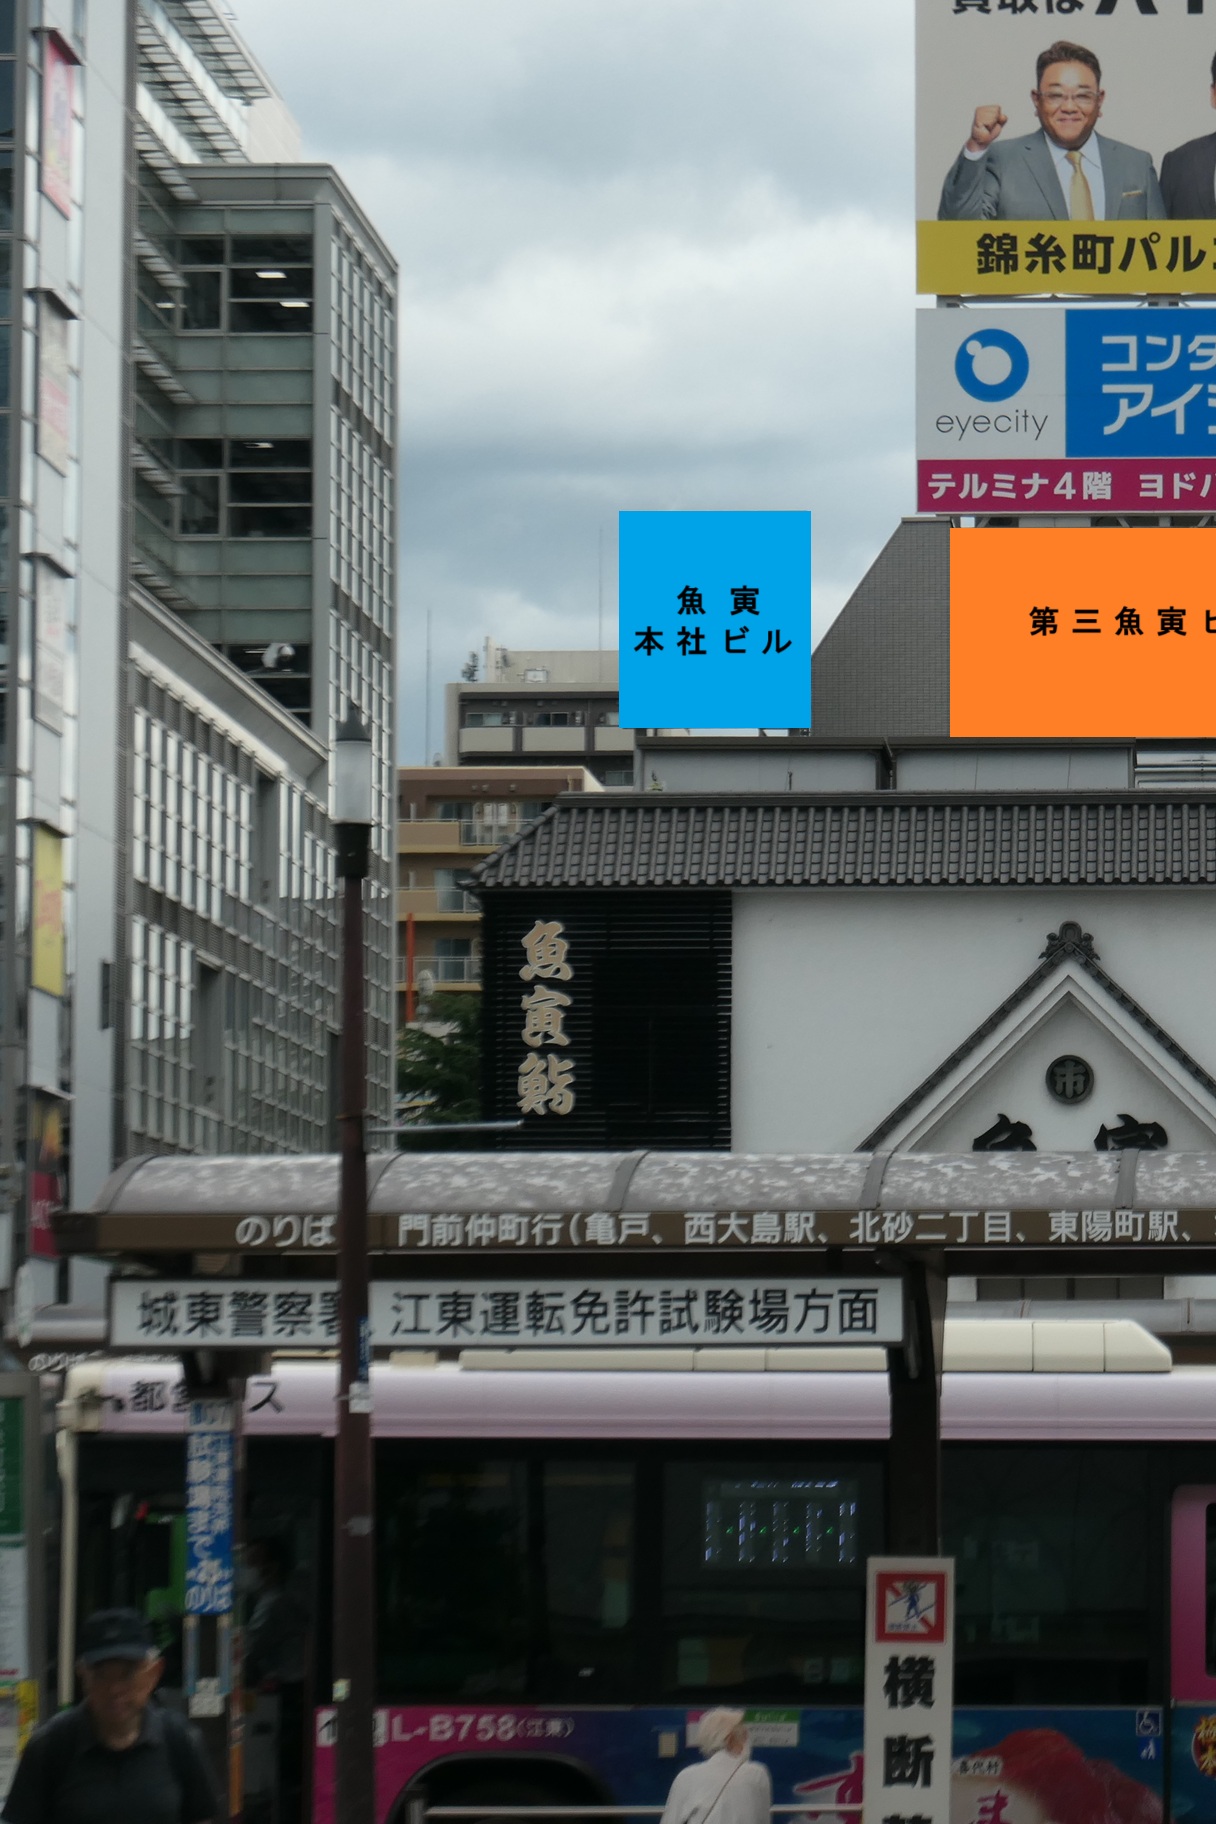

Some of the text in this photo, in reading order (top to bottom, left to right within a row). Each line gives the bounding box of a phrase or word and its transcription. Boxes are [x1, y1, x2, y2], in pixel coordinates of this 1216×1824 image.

[935, 408, 1049, 442] eyecity
[927, 471, 1113, 501] テルミナ4階
[234, 1213, 336, 1248] のりば
[881, 1655, 936, 1824] 横断
